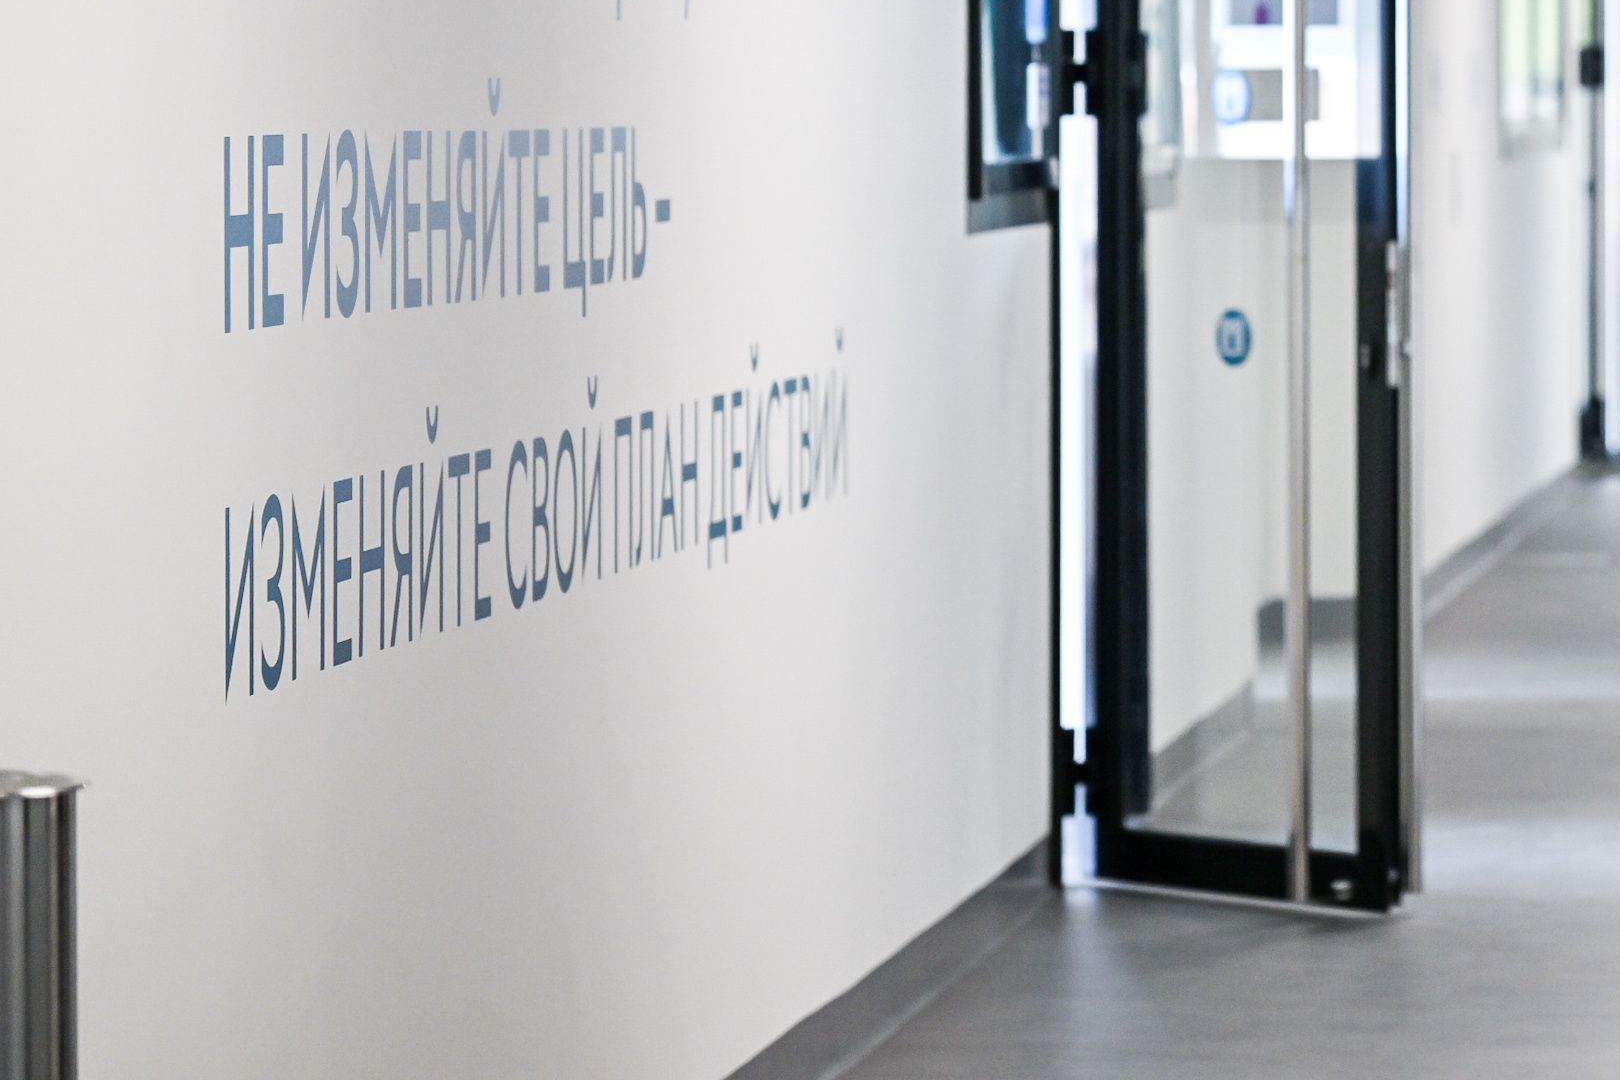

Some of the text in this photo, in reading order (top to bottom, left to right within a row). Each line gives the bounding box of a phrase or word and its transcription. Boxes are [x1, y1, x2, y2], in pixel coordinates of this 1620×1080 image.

[224, 133, 284, 334] НЕ
[301, 77, 550, 320] ИЗМЕНЯЙТЕ
[225, 324, 849, 705] ИЗМЕНЯЙТЕ СВОЙ ПЛАН ДЕЙСТВИЙ
